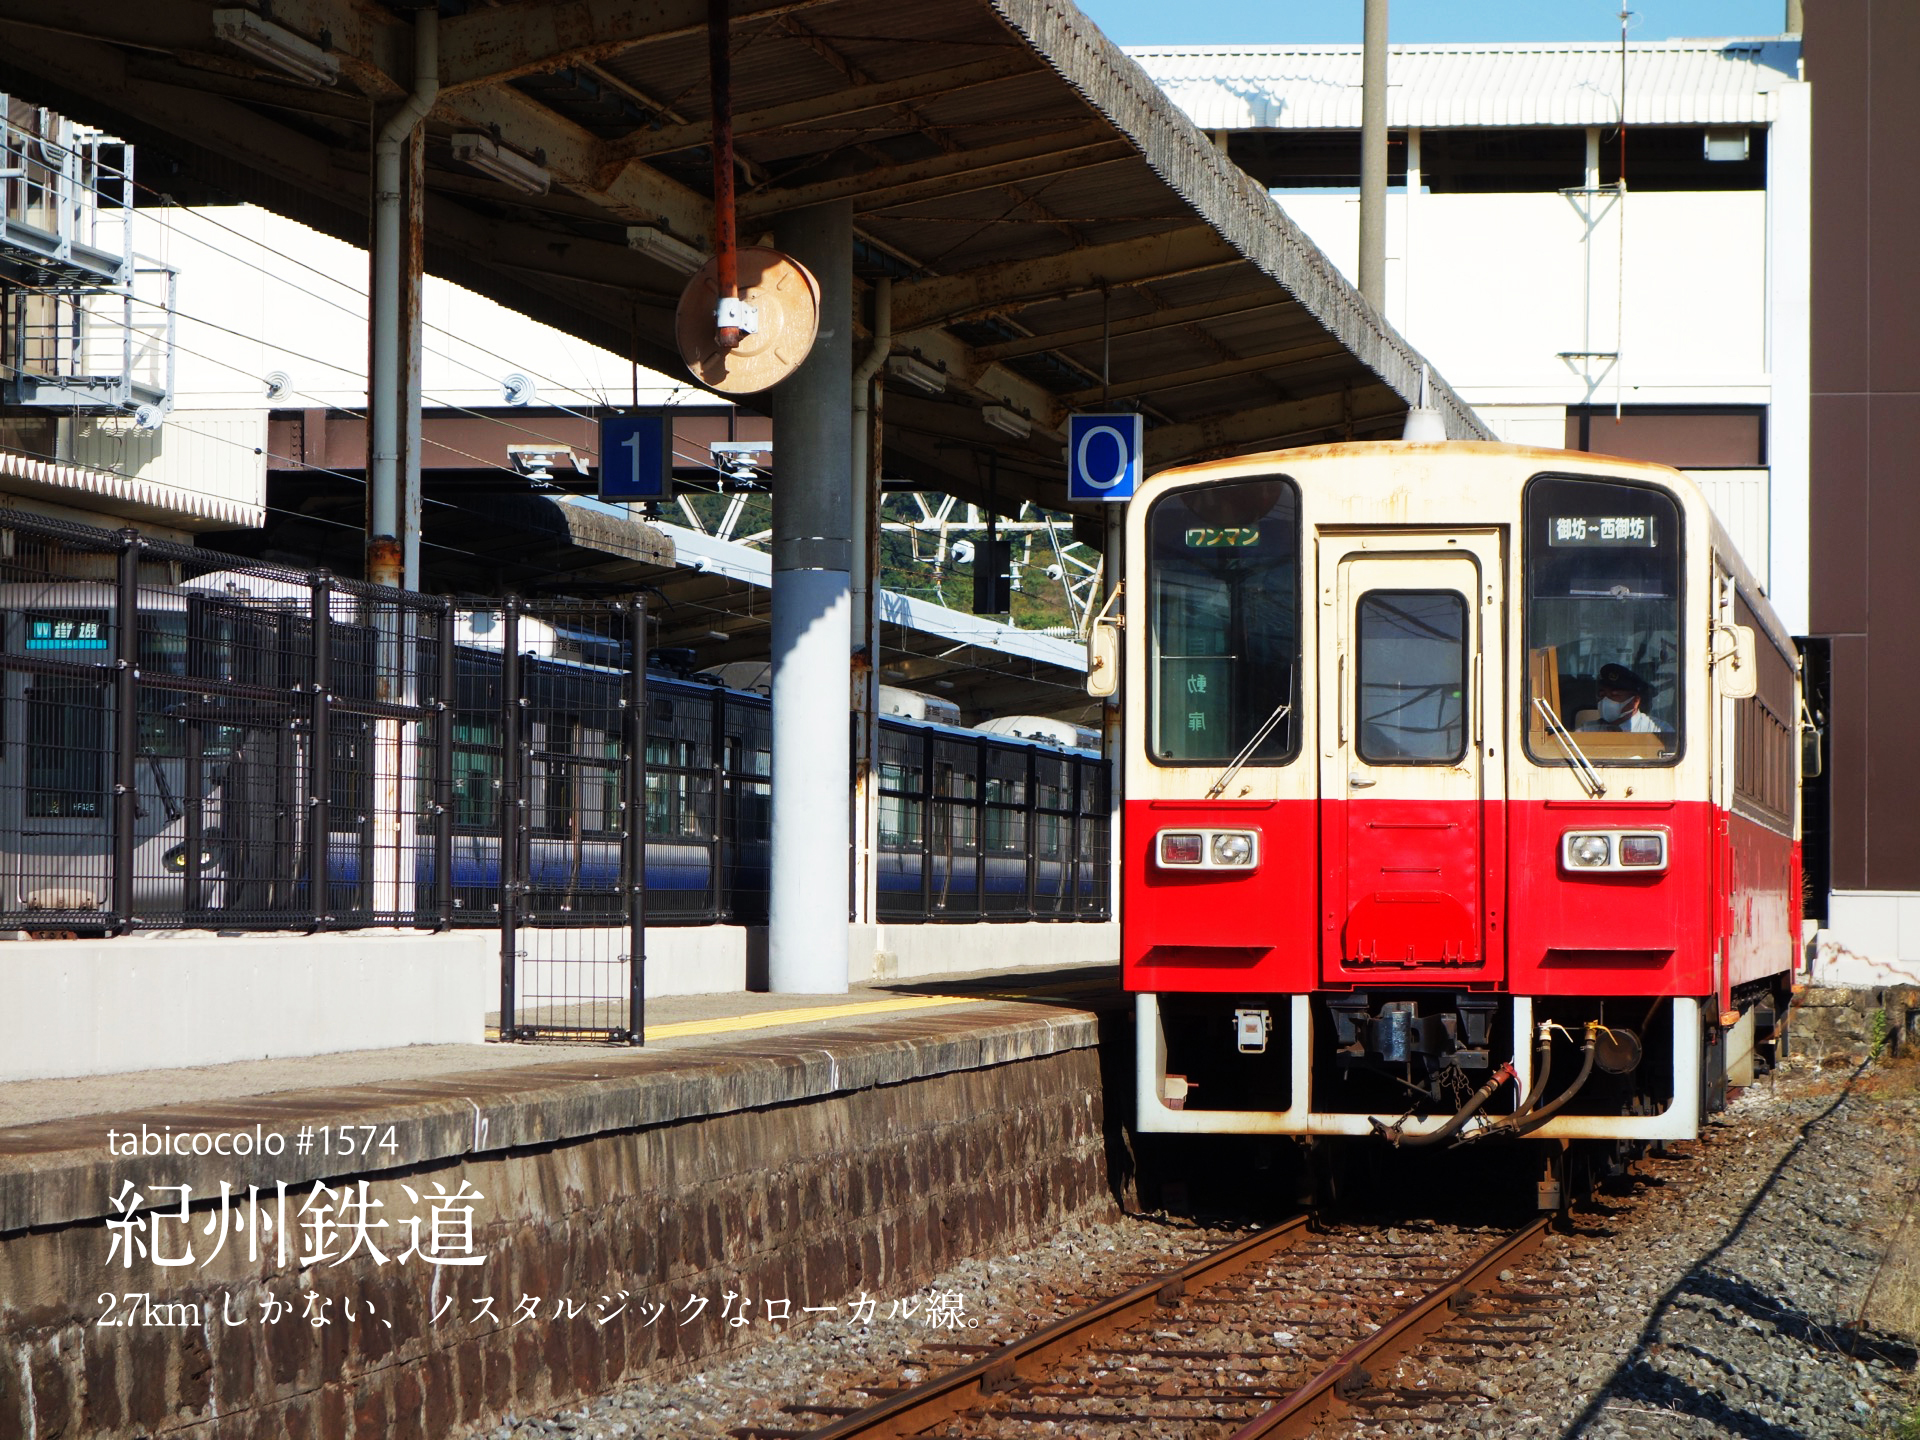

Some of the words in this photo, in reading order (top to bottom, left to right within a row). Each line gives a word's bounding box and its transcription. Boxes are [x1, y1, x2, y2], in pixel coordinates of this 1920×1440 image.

[621, 431, 640, 482] 1
[1188, 527, 1259, 546] ワンマン
[1556, 517, 1587, 540] 御坊
[1600, 517, 1645, 540] 西御坊
